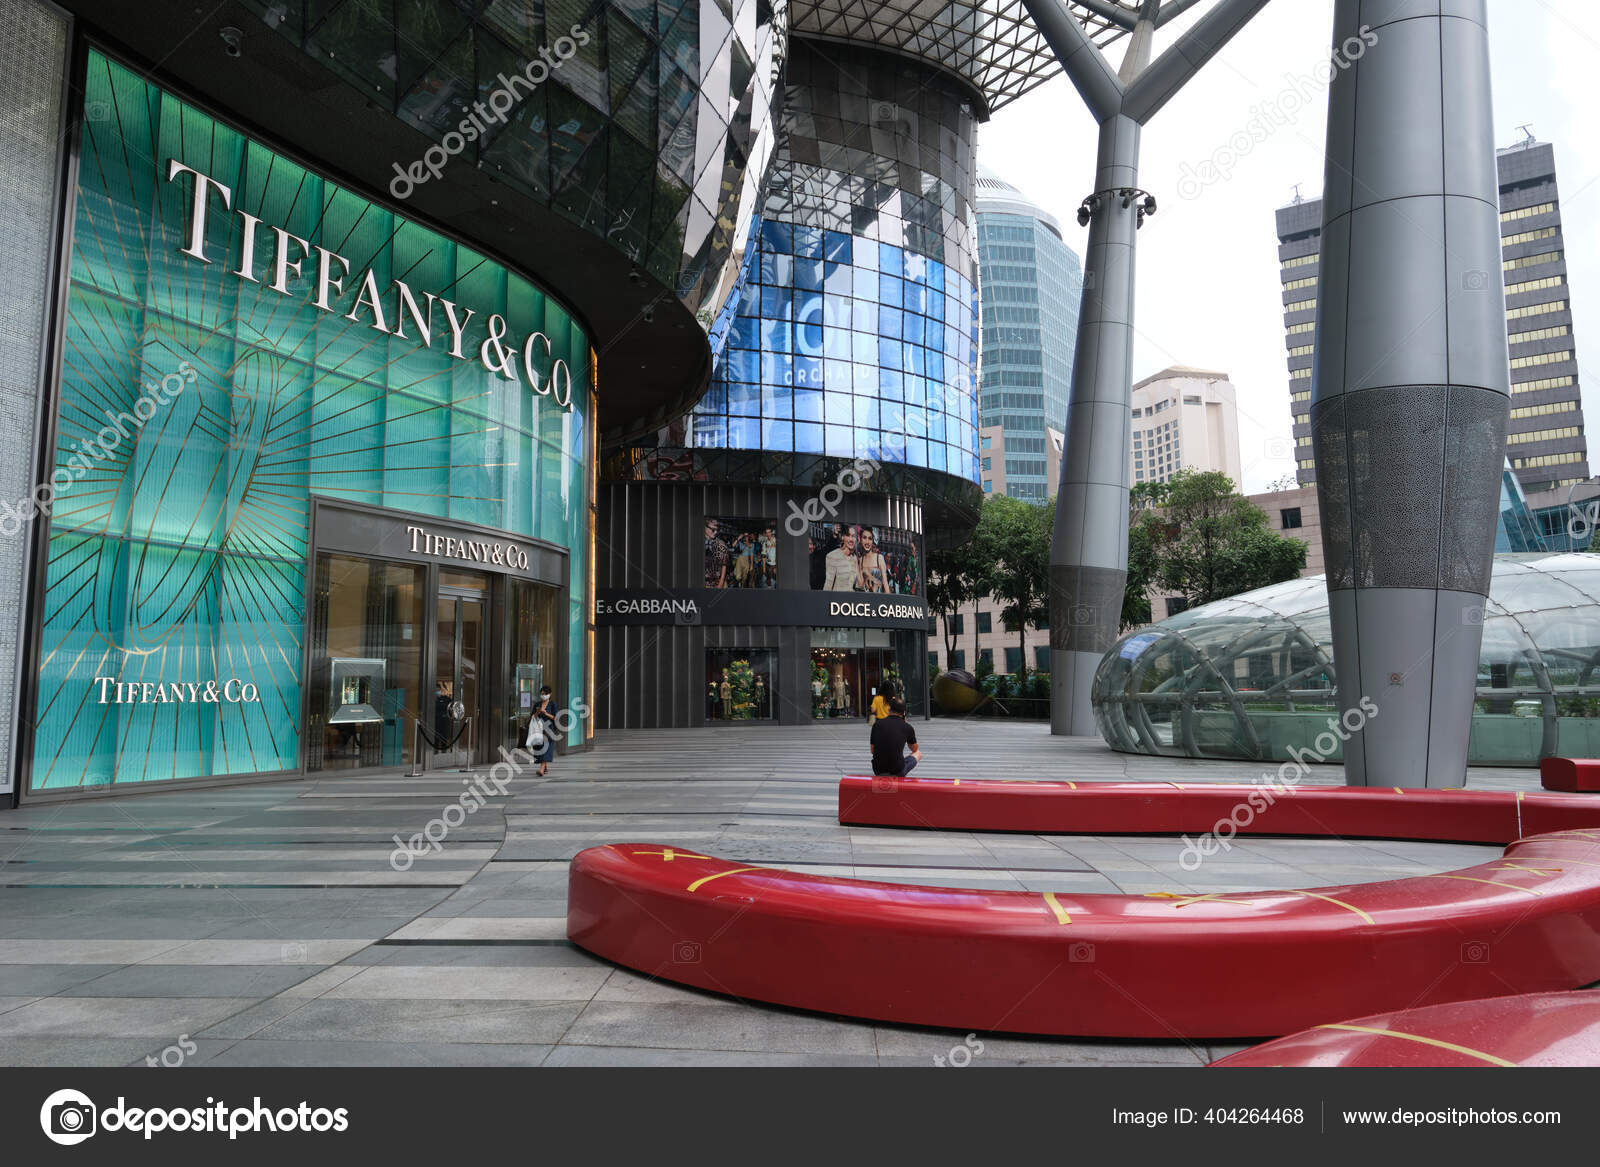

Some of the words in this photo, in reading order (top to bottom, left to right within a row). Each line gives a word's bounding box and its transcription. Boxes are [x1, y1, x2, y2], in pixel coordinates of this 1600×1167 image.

[784, 367, 870, 385] ORCHAD
[615, 599, 698, 614] GABBANA
[830, 601, 871, 617] DOLCE
[878, 604, 924, 620] GABBANA
